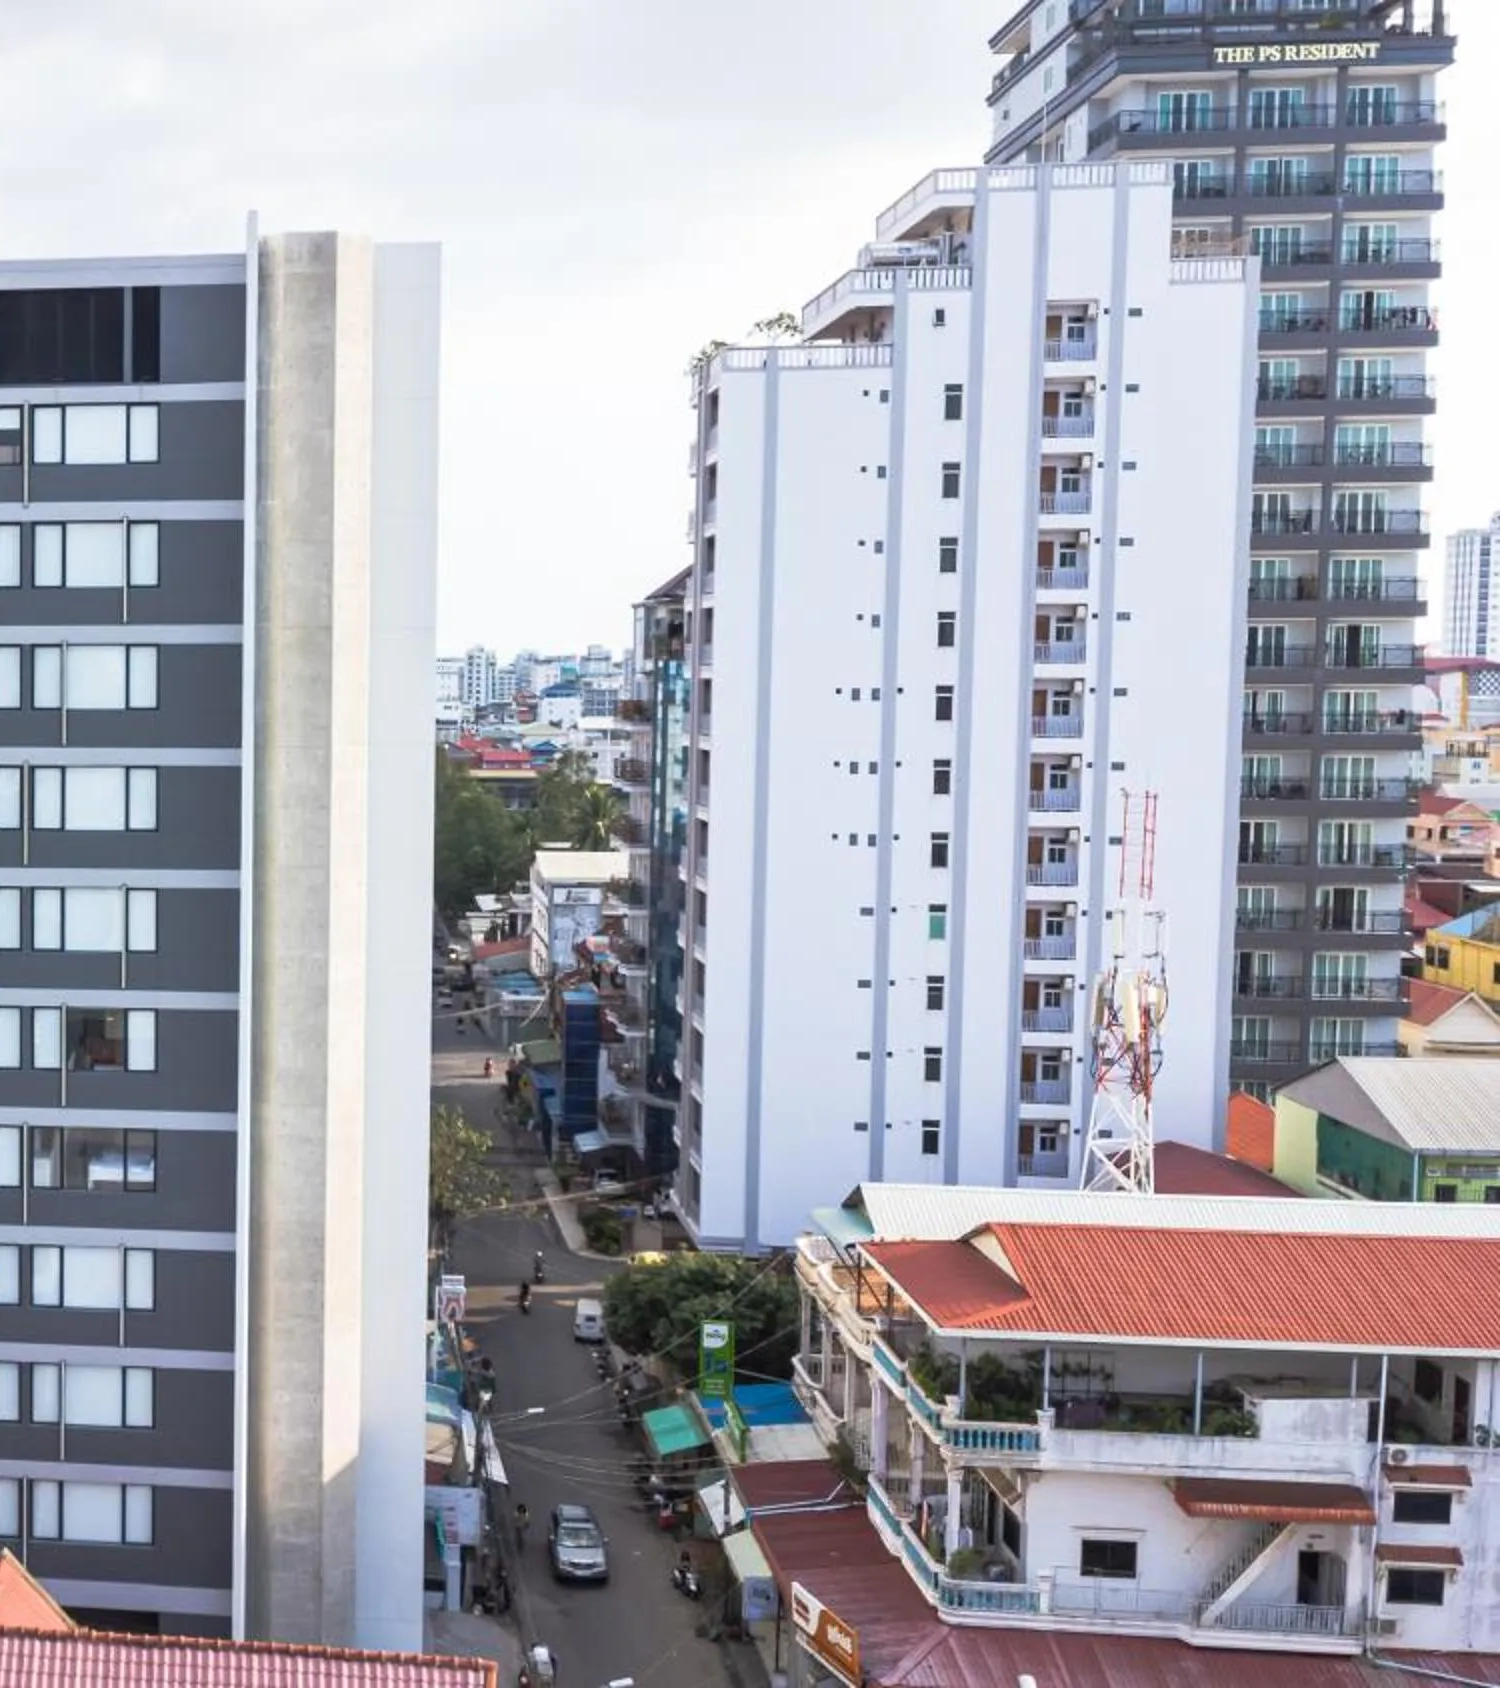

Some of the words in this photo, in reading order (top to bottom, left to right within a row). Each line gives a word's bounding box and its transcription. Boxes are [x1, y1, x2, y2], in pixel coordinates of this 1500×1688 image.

[1213, 46, 1255, 63] THE
[1259, 45, 1282, 62] PS
[1284, 42, 1381, 61] RESIDENT
